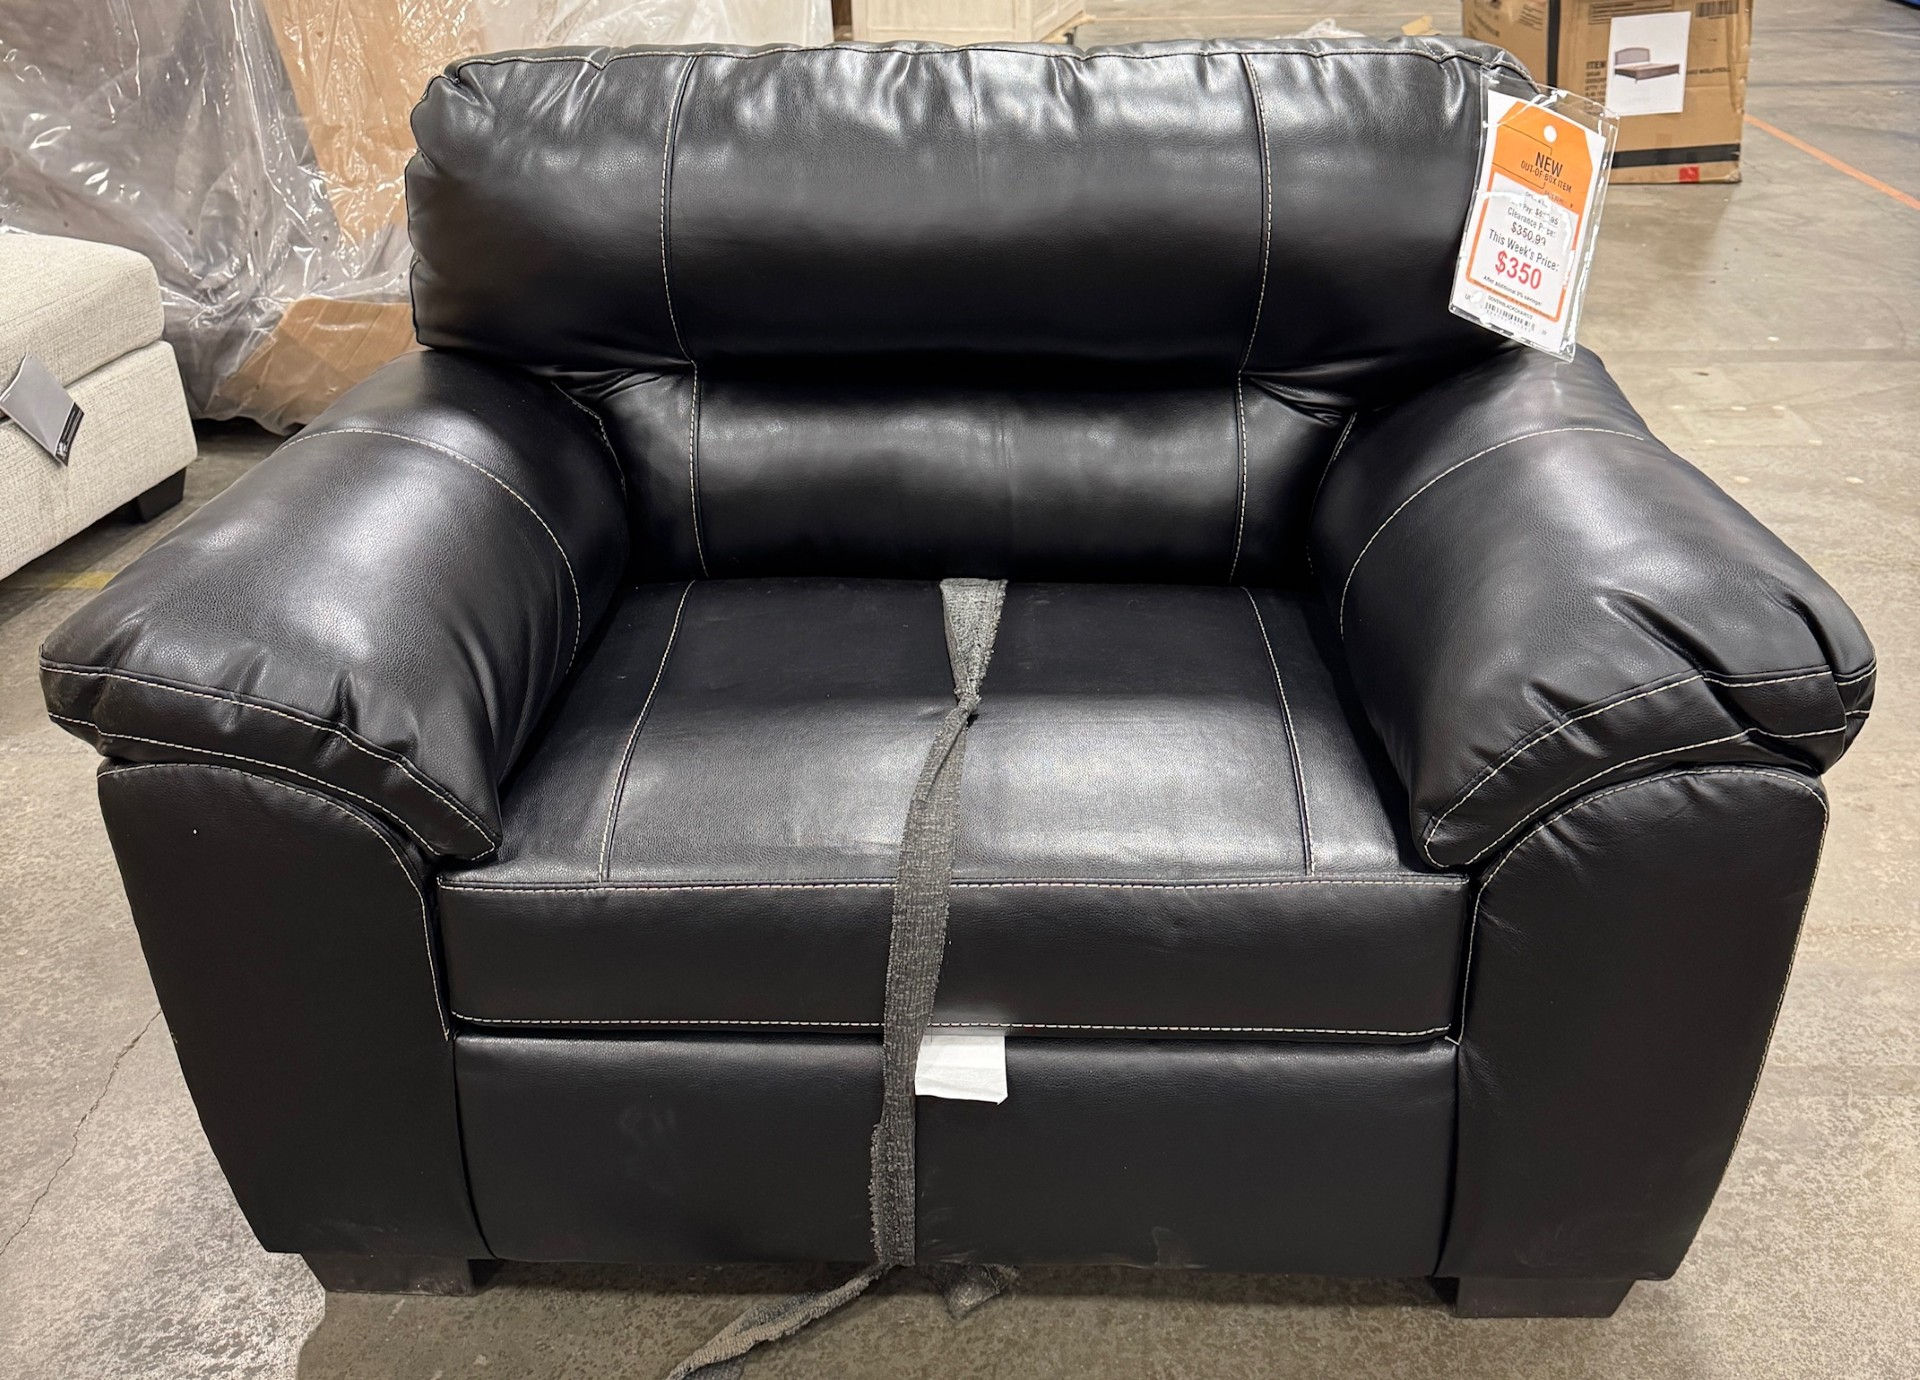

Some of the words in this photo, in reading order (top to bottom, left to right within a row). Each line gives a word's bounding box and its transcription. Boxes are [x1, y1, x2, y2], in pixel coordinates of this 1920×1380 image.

[1535, 152, 1564, 177] NEW
[1558, 182, 1572, 193] ITEM
[1507, 207, 1537, 229] Clearance
[1489, 228, 1506, 246] This
[1507, 237, 1535, 260] Week's
[1536, 253, 1560, 272] Price:
[1494, 250, 1542, 290] $350
